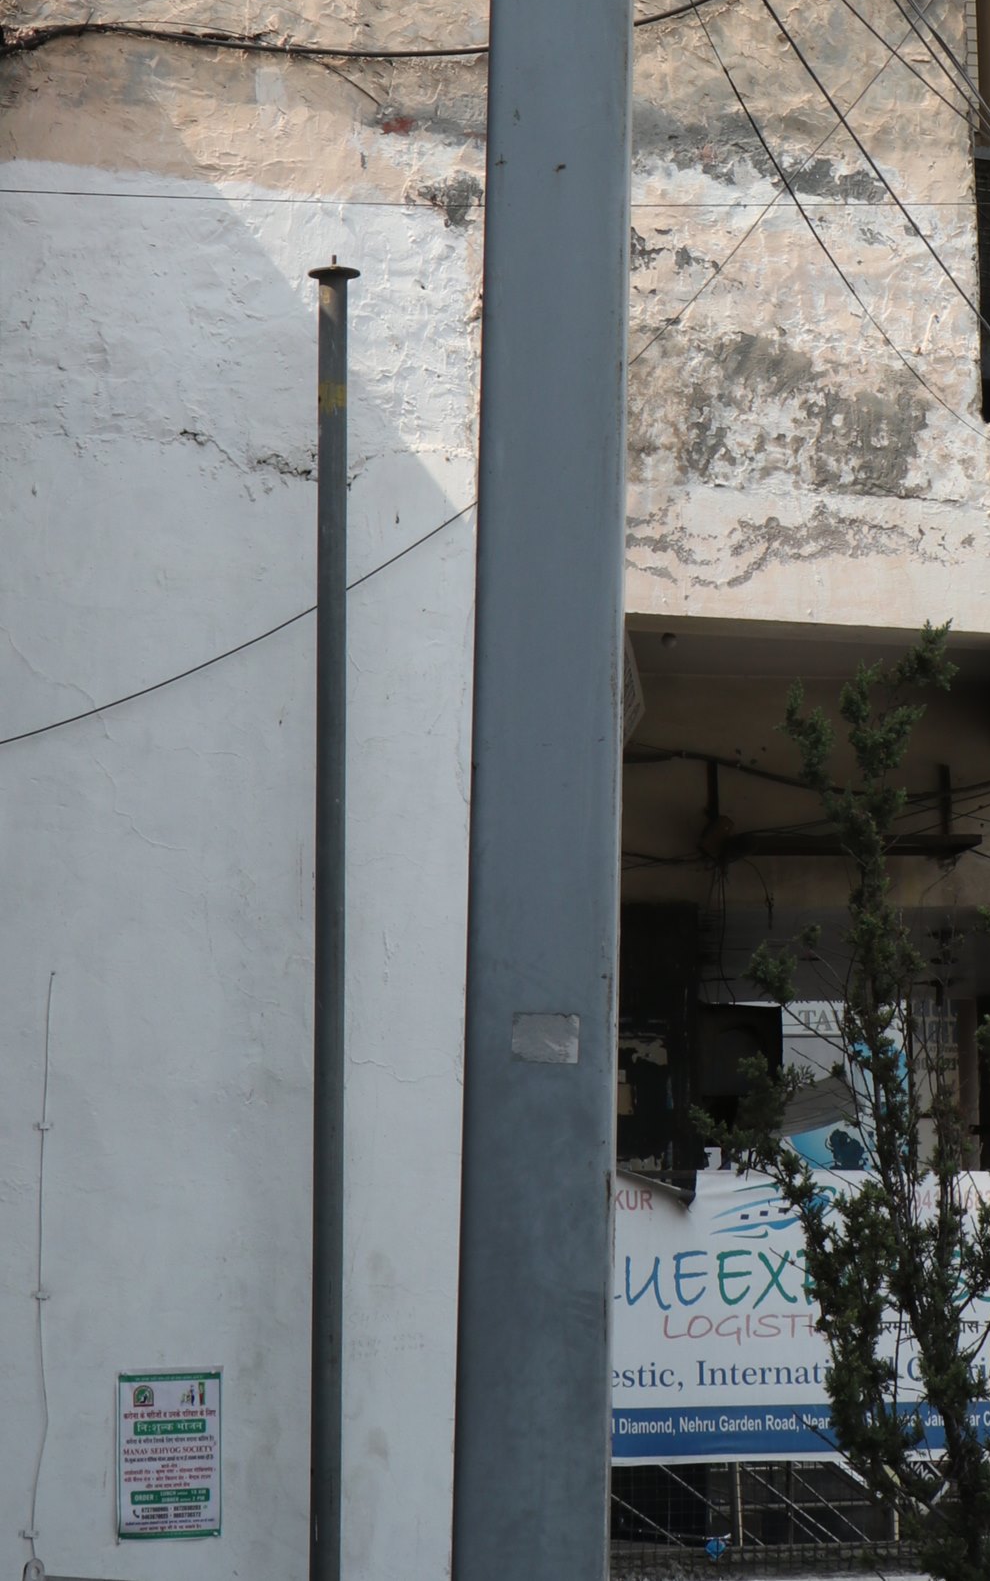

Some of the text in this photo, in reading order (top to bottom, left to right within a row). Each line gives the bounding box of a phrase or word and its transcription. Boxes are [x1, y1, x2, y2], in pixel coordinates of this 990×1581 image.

[619, 1417, 676, 1437] Diamond,
[680, 1416, 716, 1433] Nehru
[719, 1415, 762, 1432] Garden
[766, 1414, 800, 1432] Road,
[123, 1445, 213, 1456] MANAV SEHYOG SOCIETY
